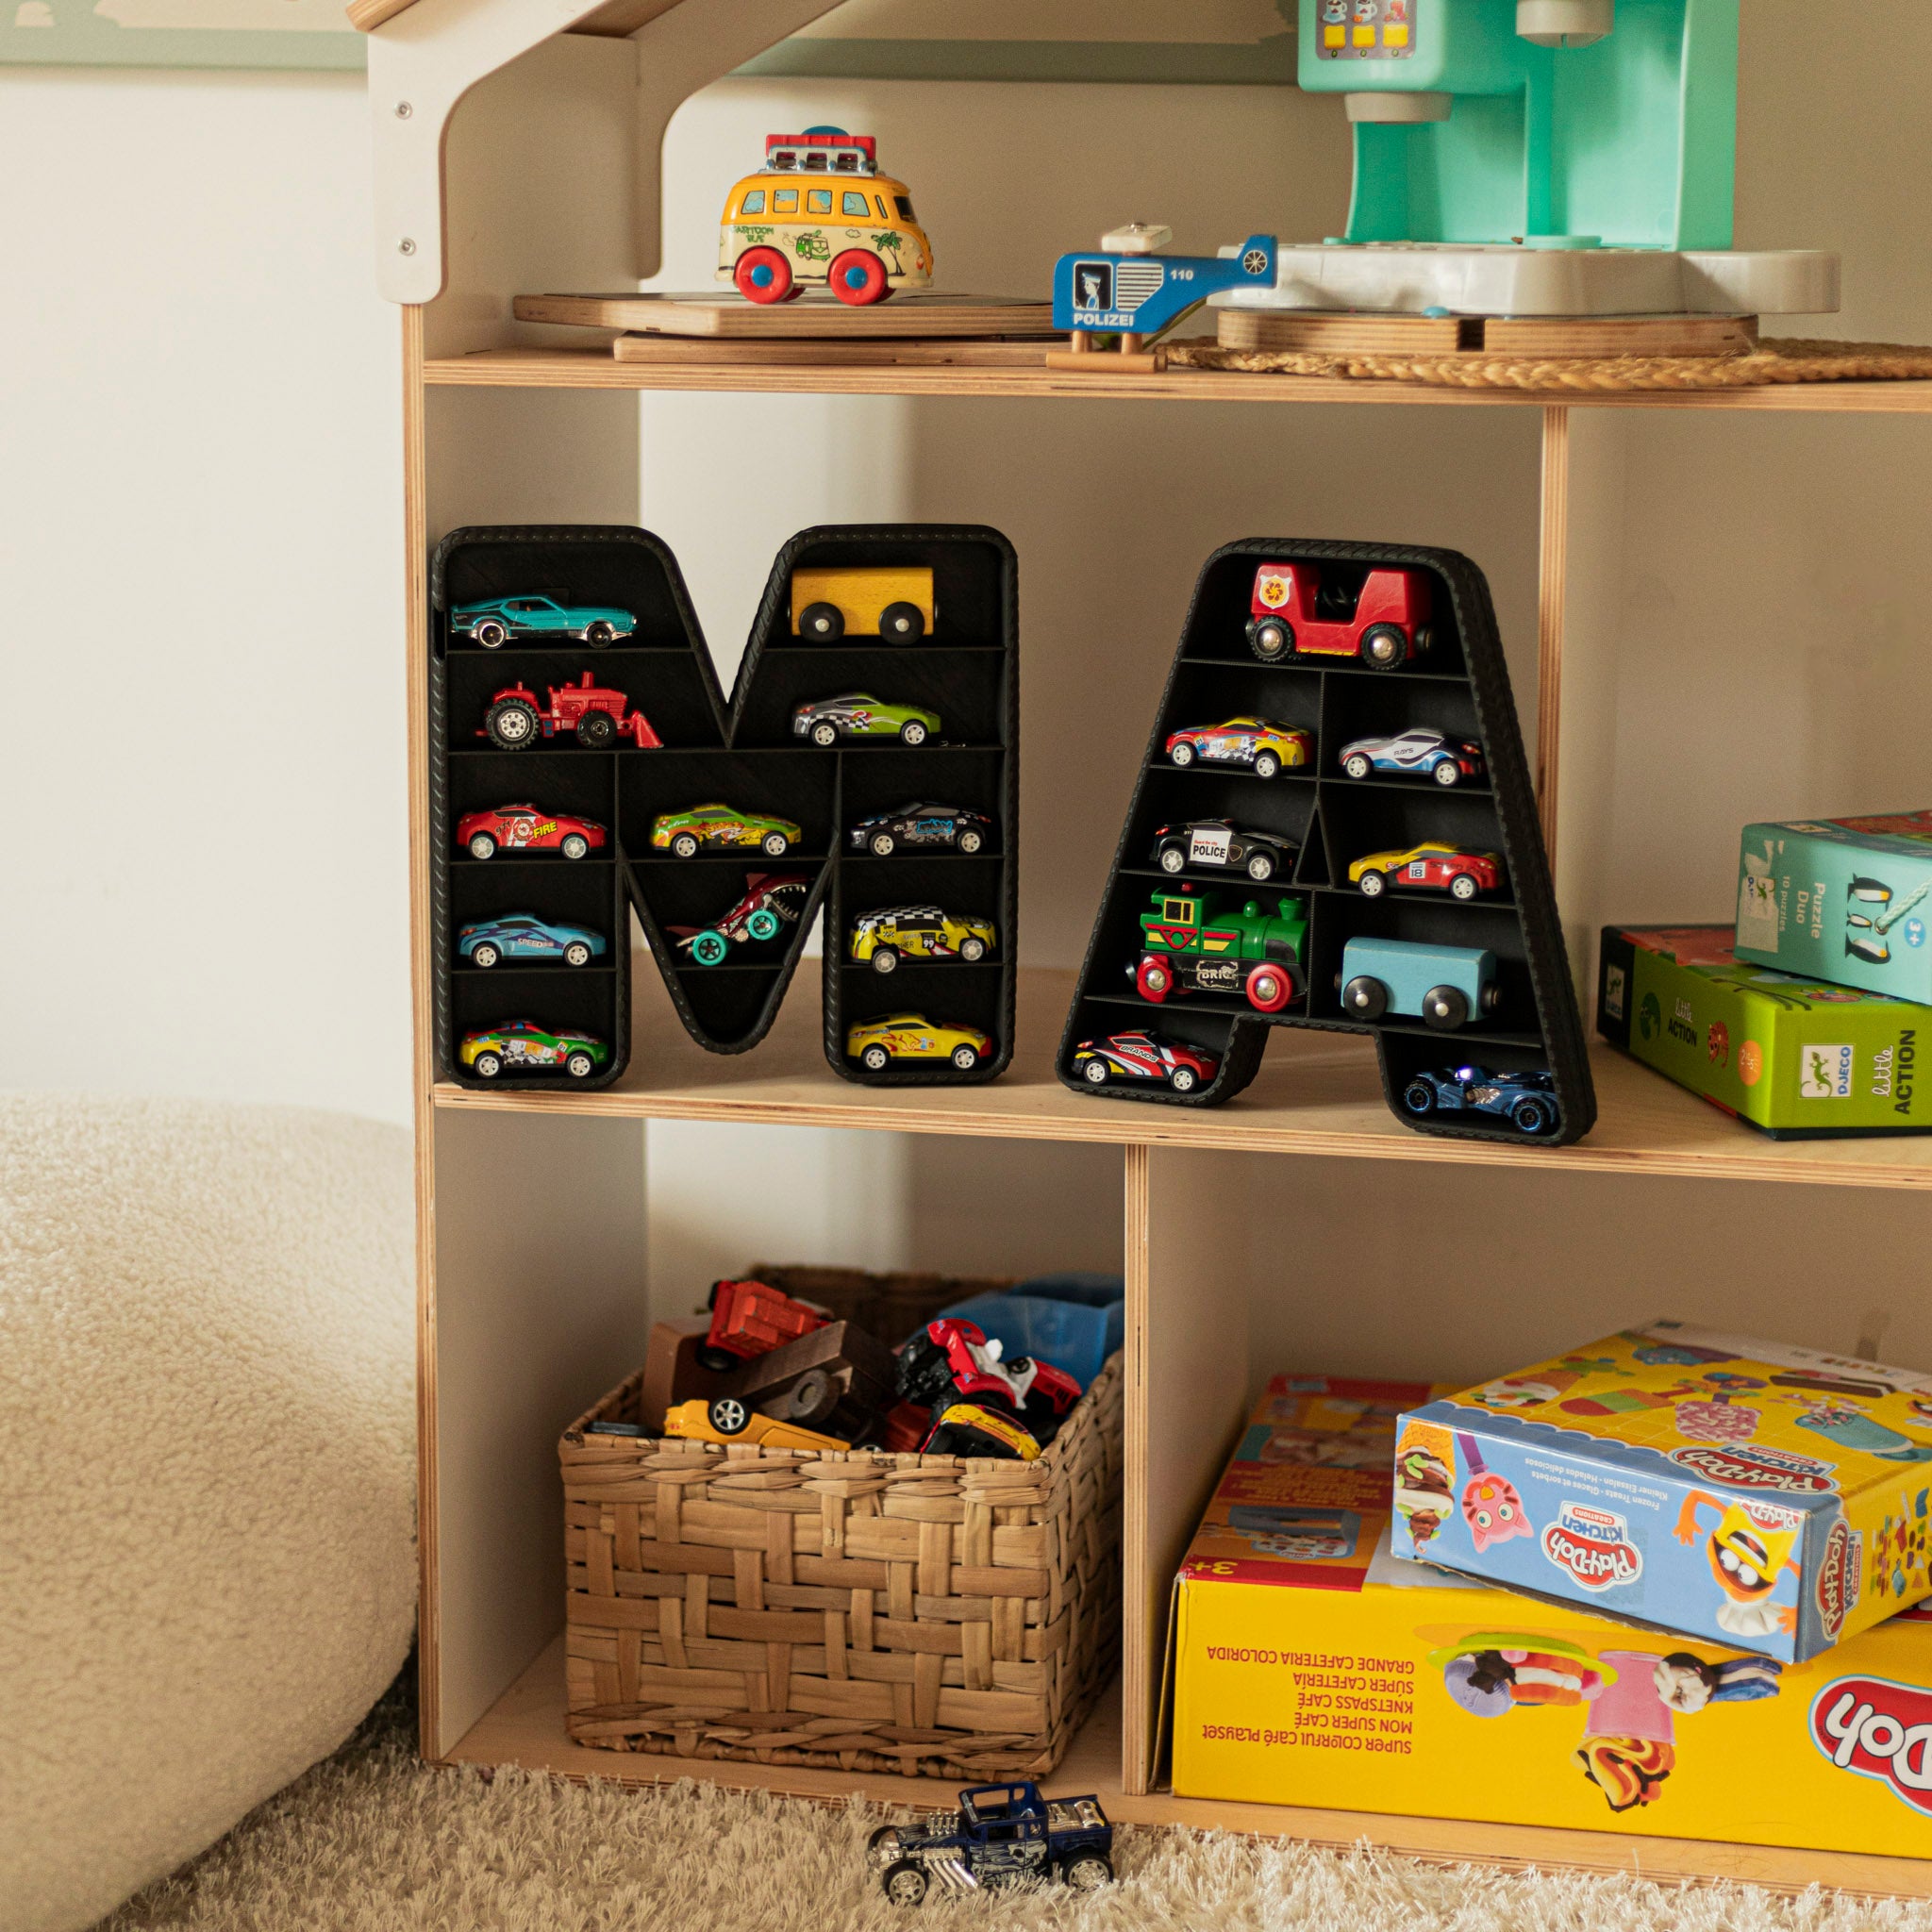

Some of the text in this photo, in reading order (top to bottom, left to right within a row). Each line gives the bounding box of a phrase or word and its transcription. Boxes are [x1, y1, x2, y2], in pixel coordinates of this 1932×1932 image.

[1171, 269, 1194, 281] 110
[1073, 312, 1135, 327] POLIZEI
[533, 821, 558, 840] FIRE
[1192, 844, 1226, 858] POLICE
[1779, 891, 1788, 932] puzzles
[1796, 890, 1809, 924] Duo
[1811, 882, 1825, 940] Puzzle
[923, 939, 935, 948] 99
[1668, 1018, 1697, 1047] ACTION
[1120, 1044, 1159, 1062] BRANDS
[1838, 1046, 1852, 1095] DJECO
[1872, 1044, 1894, 1097] little
[1894, 1029, 1917, 1115] ACTION
[1524, 1457, 1668, 1501] Kleiner Eissalon Helados deliciosos
[1679, 1452, 1820, 1491] Play-Doh
[1531, 1470, 1660, 1510] Frozen Treats Glaces et sorbets
[1188, 1561, 1239, 1575] 3+
[1550, 1531, 1636, 1580] Play-Doh
[1824, 1529, 1845, 1634] Play-Doh
[1207, 1646, 1414, 1674] GRANDE CAFETERIA COLORIDA
[1293, 1673, 1414, 1697] SÚPER CAFETERÍA
[1297, 1692, 1413, 1714] KNETSPASS CAFÉ
[1294, 1712, 1412, 1734] MON SUPER CAFÉ
